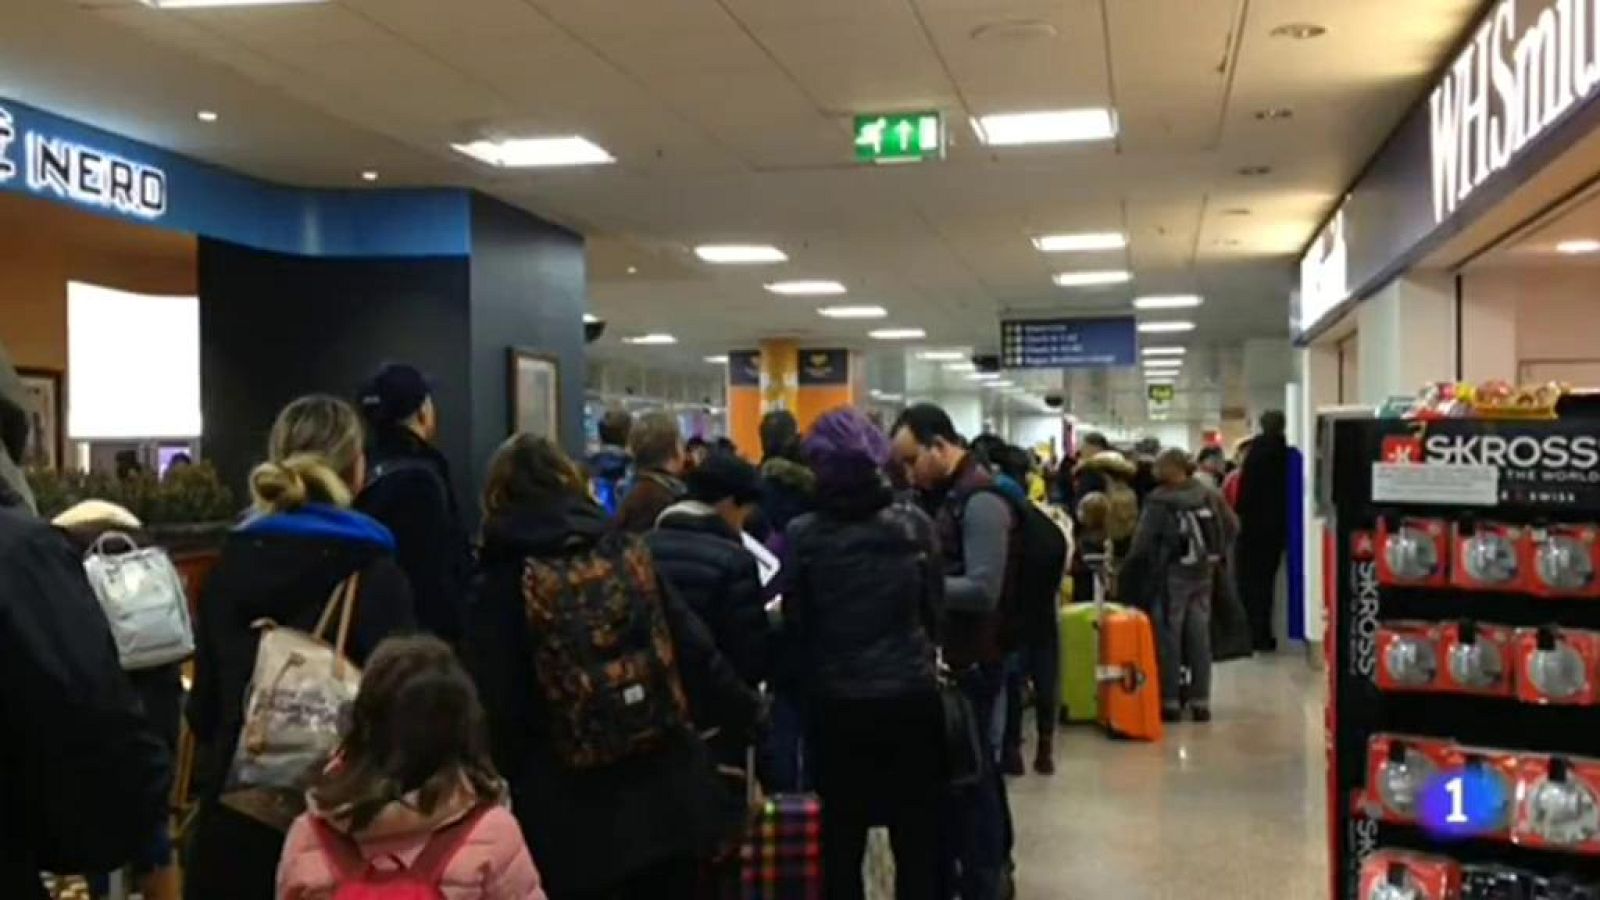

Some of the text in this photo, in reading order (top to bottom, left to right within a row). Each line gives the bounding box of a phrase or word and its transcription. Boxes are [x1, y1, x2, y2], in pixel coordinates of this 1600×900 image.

[27, 132, 166, 217] NERO
[1426, 434, 1599, 468] SKROSS
[1358, 561, 1379, 676] SKROSS
